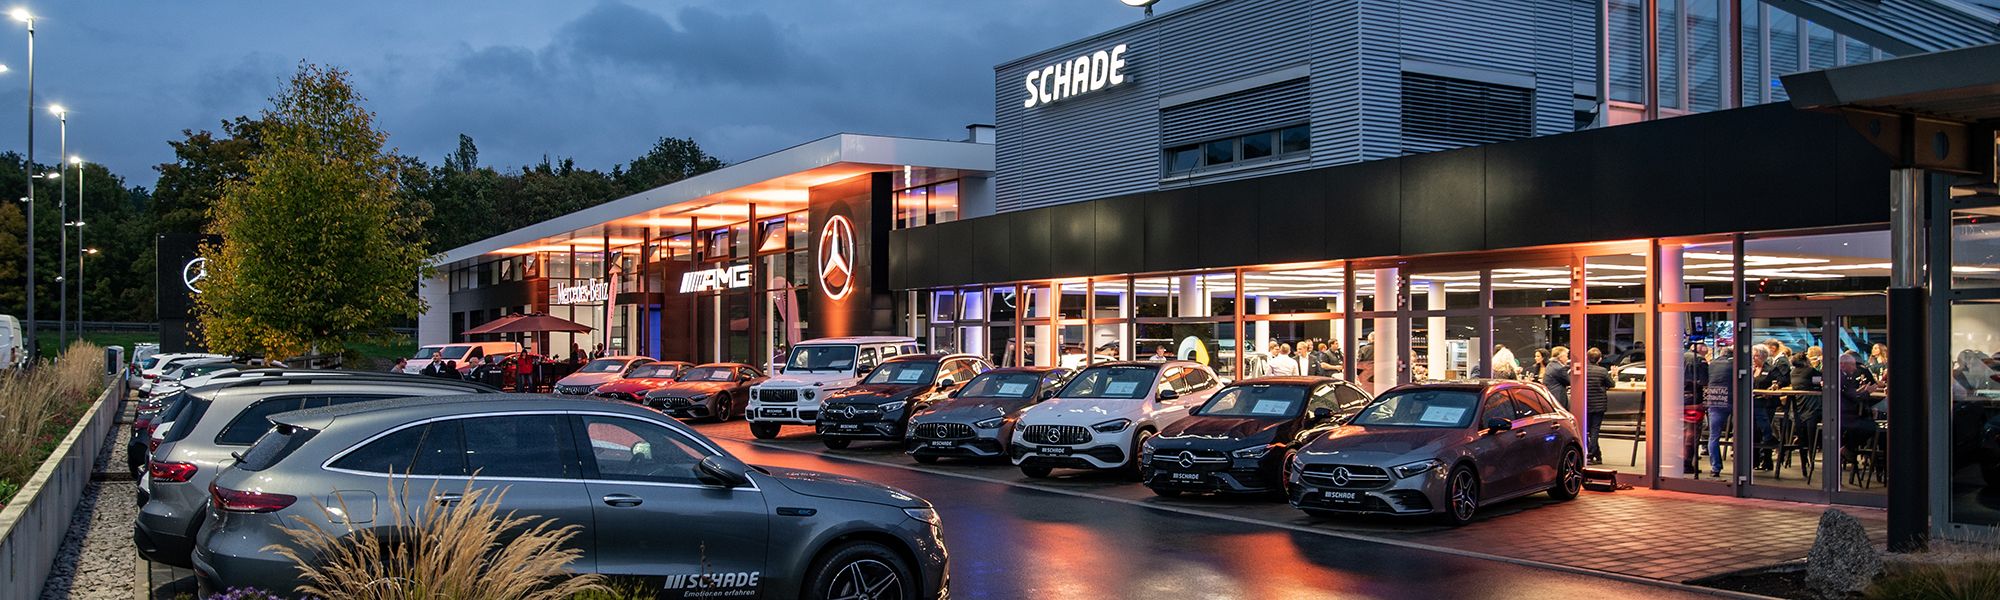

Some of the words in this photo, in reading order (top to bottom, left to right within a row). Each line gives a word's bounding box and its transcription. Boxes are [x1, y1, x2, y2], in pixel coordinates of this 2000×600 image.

[1024, 44, 1127, 108] SCHADE
[697, 264, 753, 291] AMG
[557, 278, 609, 305] Mercedes-Benz
[1331, 491, 1355, 499] SCHADE
[687, 572, 759, 588] SCHADE
